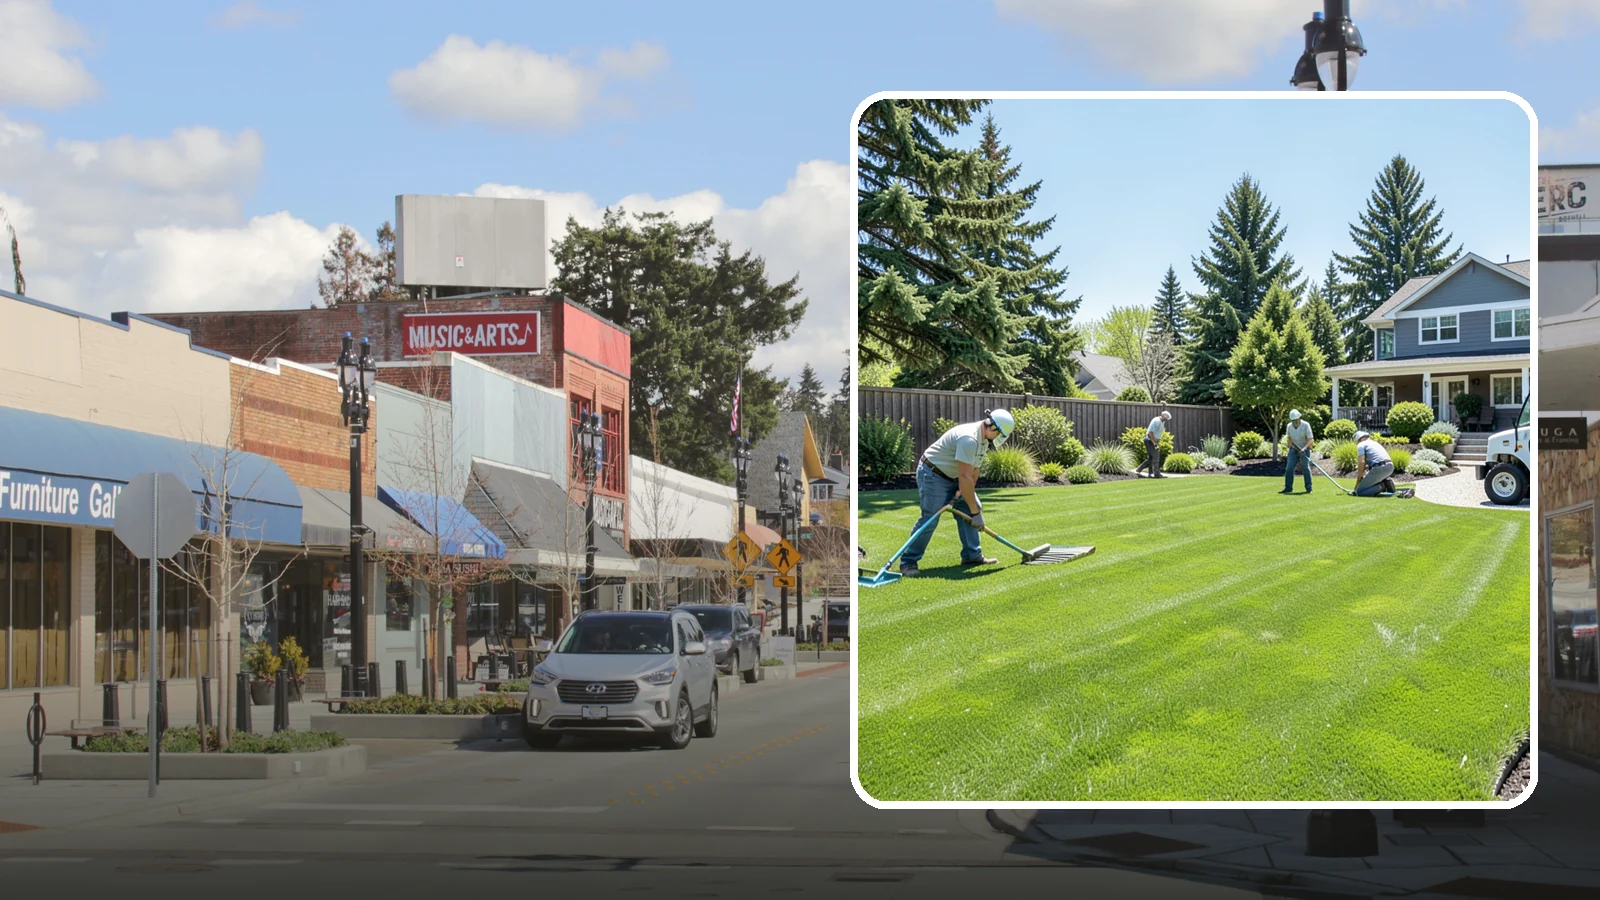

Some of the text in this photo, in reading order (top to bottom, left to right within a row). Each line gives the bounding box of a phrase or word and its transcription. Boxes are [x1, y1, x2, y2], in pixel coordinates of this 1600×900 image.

[409, 323, 519, 349] MUSIC&ARTS
[0, 471, 122, 519] Furniture Gal
[453, 562, 479, 575] SUSHI
